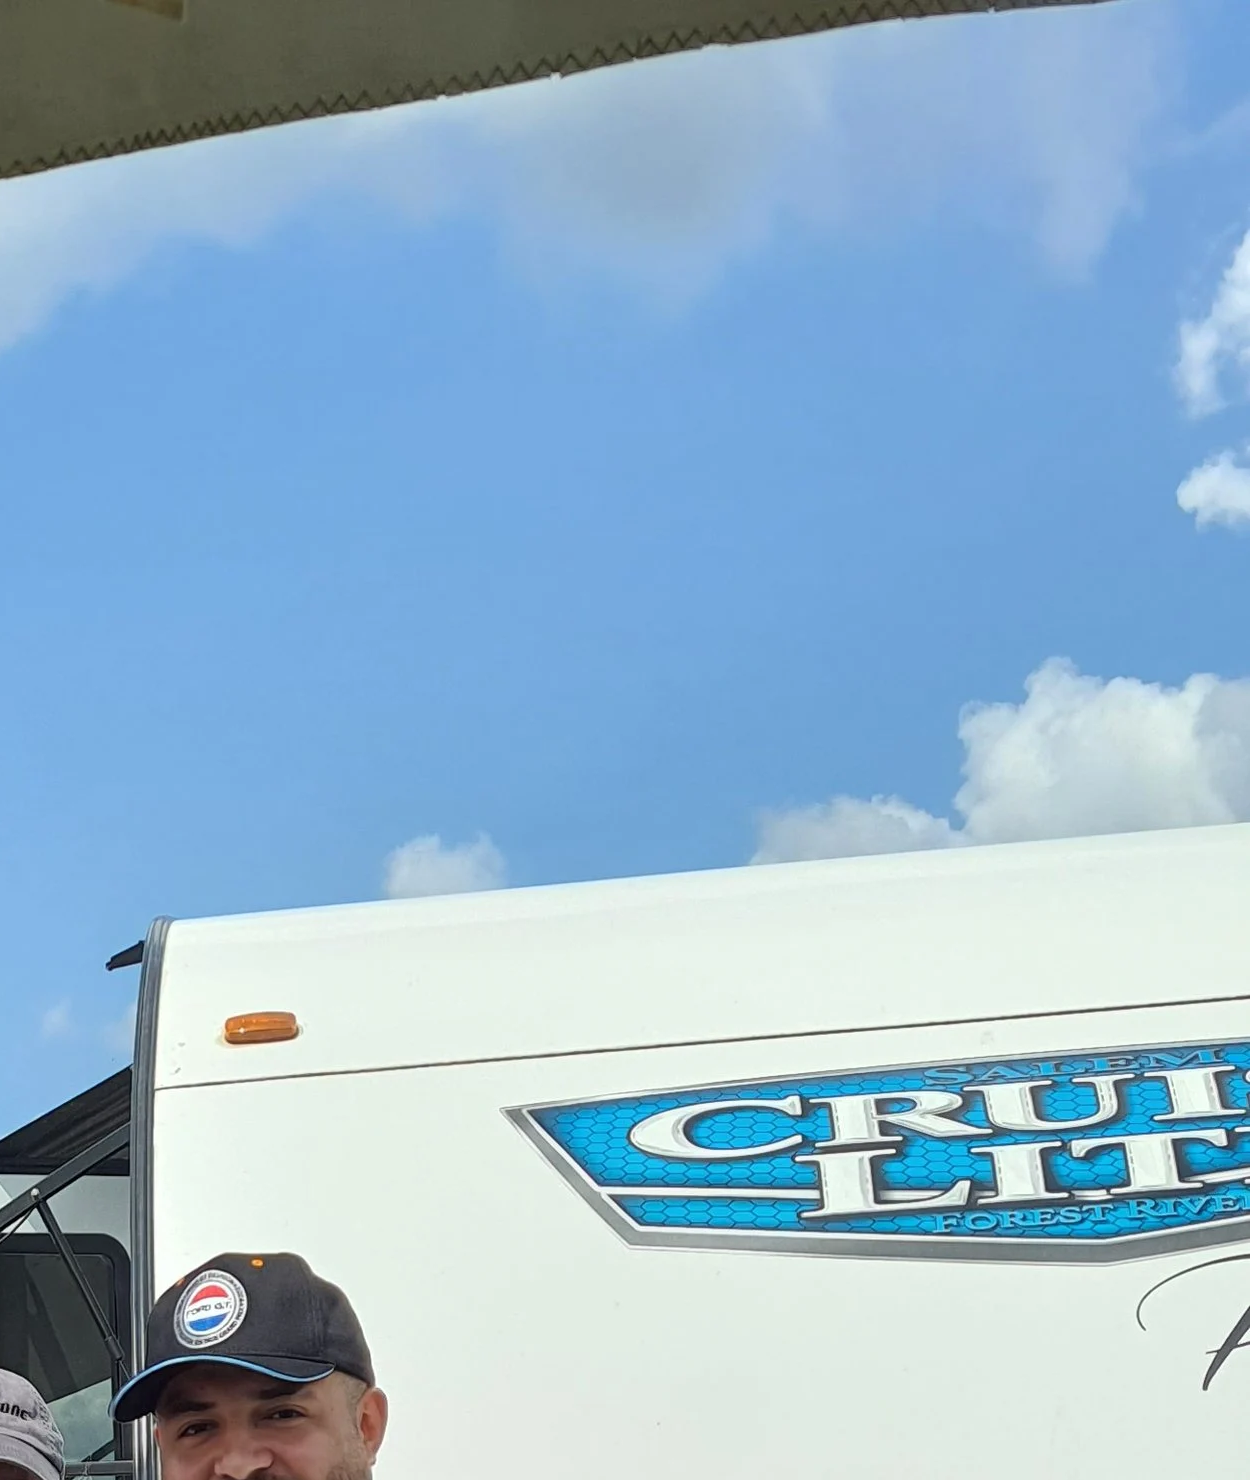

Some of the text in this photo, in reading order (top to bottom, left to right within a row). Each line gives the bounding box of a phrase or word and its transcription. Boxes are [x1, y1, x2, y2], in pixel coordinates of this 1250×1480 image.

[924, 1049, 1224, 1085] SALEM
[629, 1065, 1250, 1160] CRUI
[795, 1126, 1250, 1219] LIT
[933, 1204, 1114, 1233] FOREST
